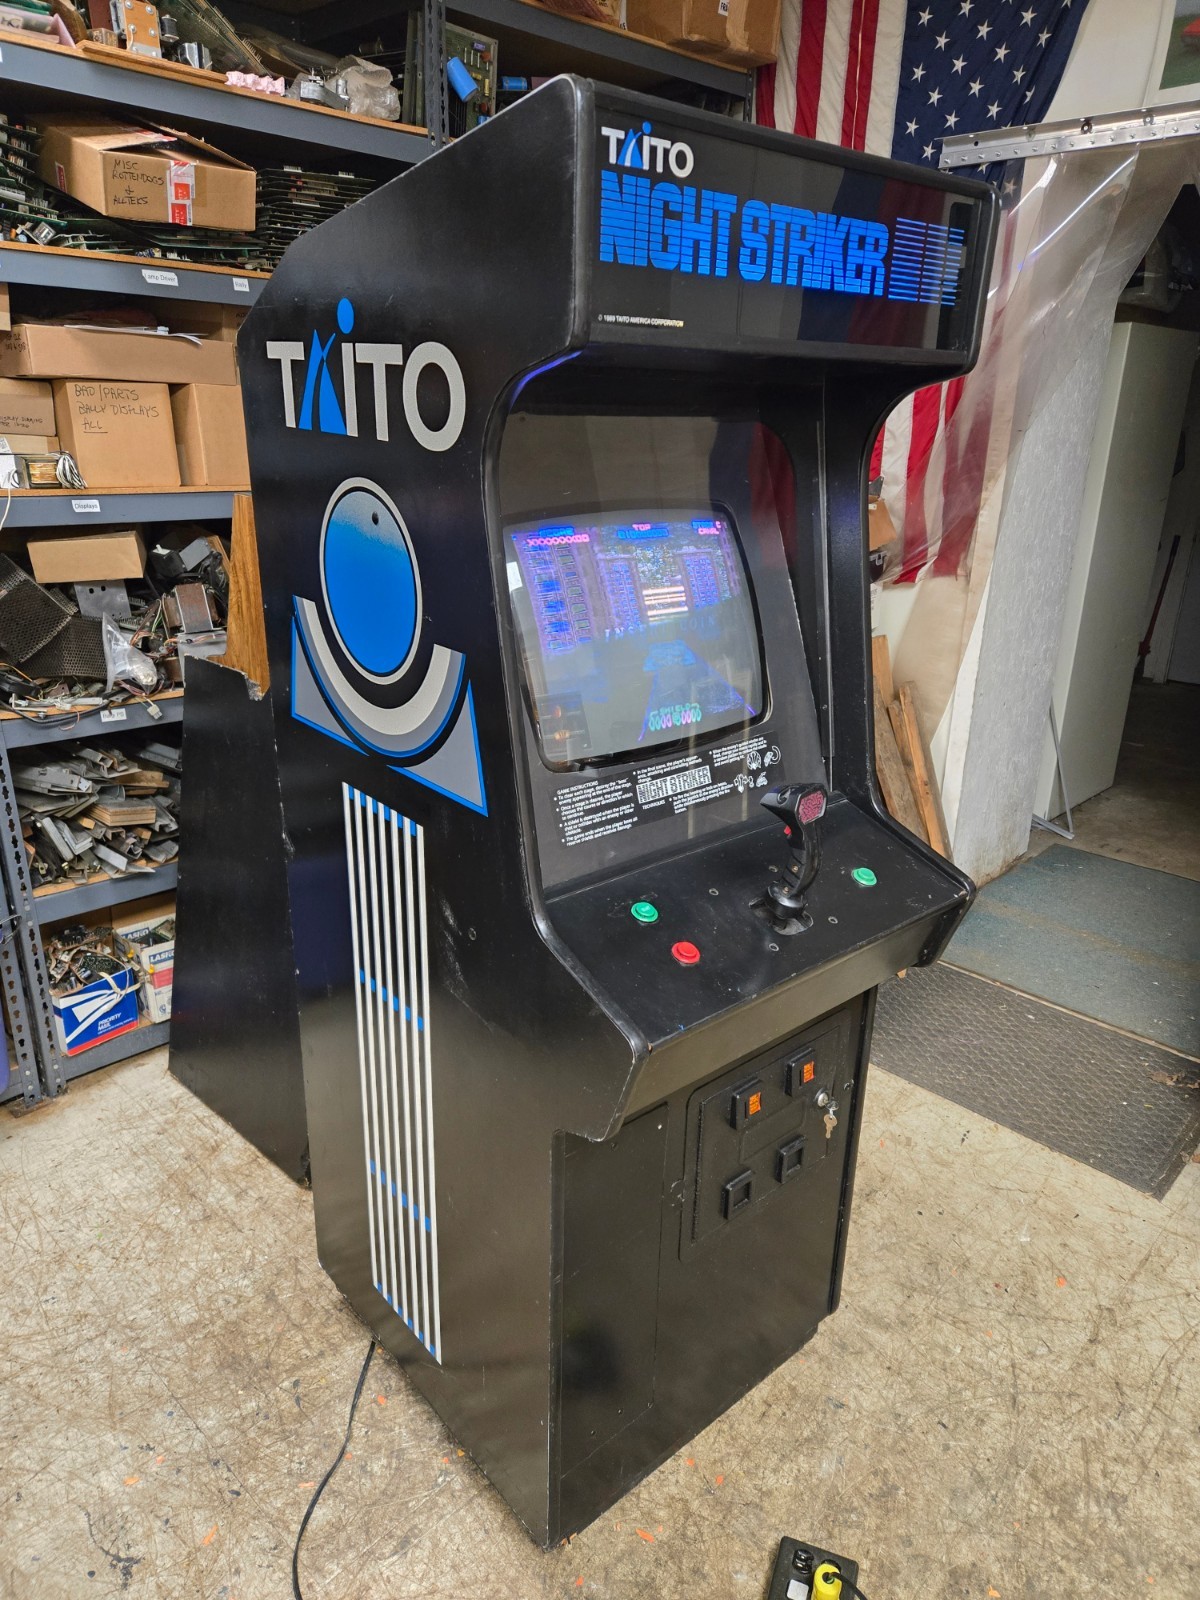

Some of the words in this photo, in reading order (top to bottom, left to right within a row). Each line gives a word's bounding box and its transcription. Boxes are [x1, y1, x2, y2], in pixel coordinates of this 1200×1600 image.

[114, 159, 138, 170] MISC
[601, 121, 694, 178] TAITO
[600, 170, 737, 277] NIGHT
[738, 199, 889, 296] STRIKER
[616, 315, 630, 324] TAITO
[630, 316, 651, 325] AMERICA
[651, 318, 684, 327] CORPORATION
[267, 297, 466, 452] TAITO
[110, 404, 159, 418] DISPLAYS
[637, 778, 668, 803] NIGHT
[670, 766, 710, 792] STRIKER
